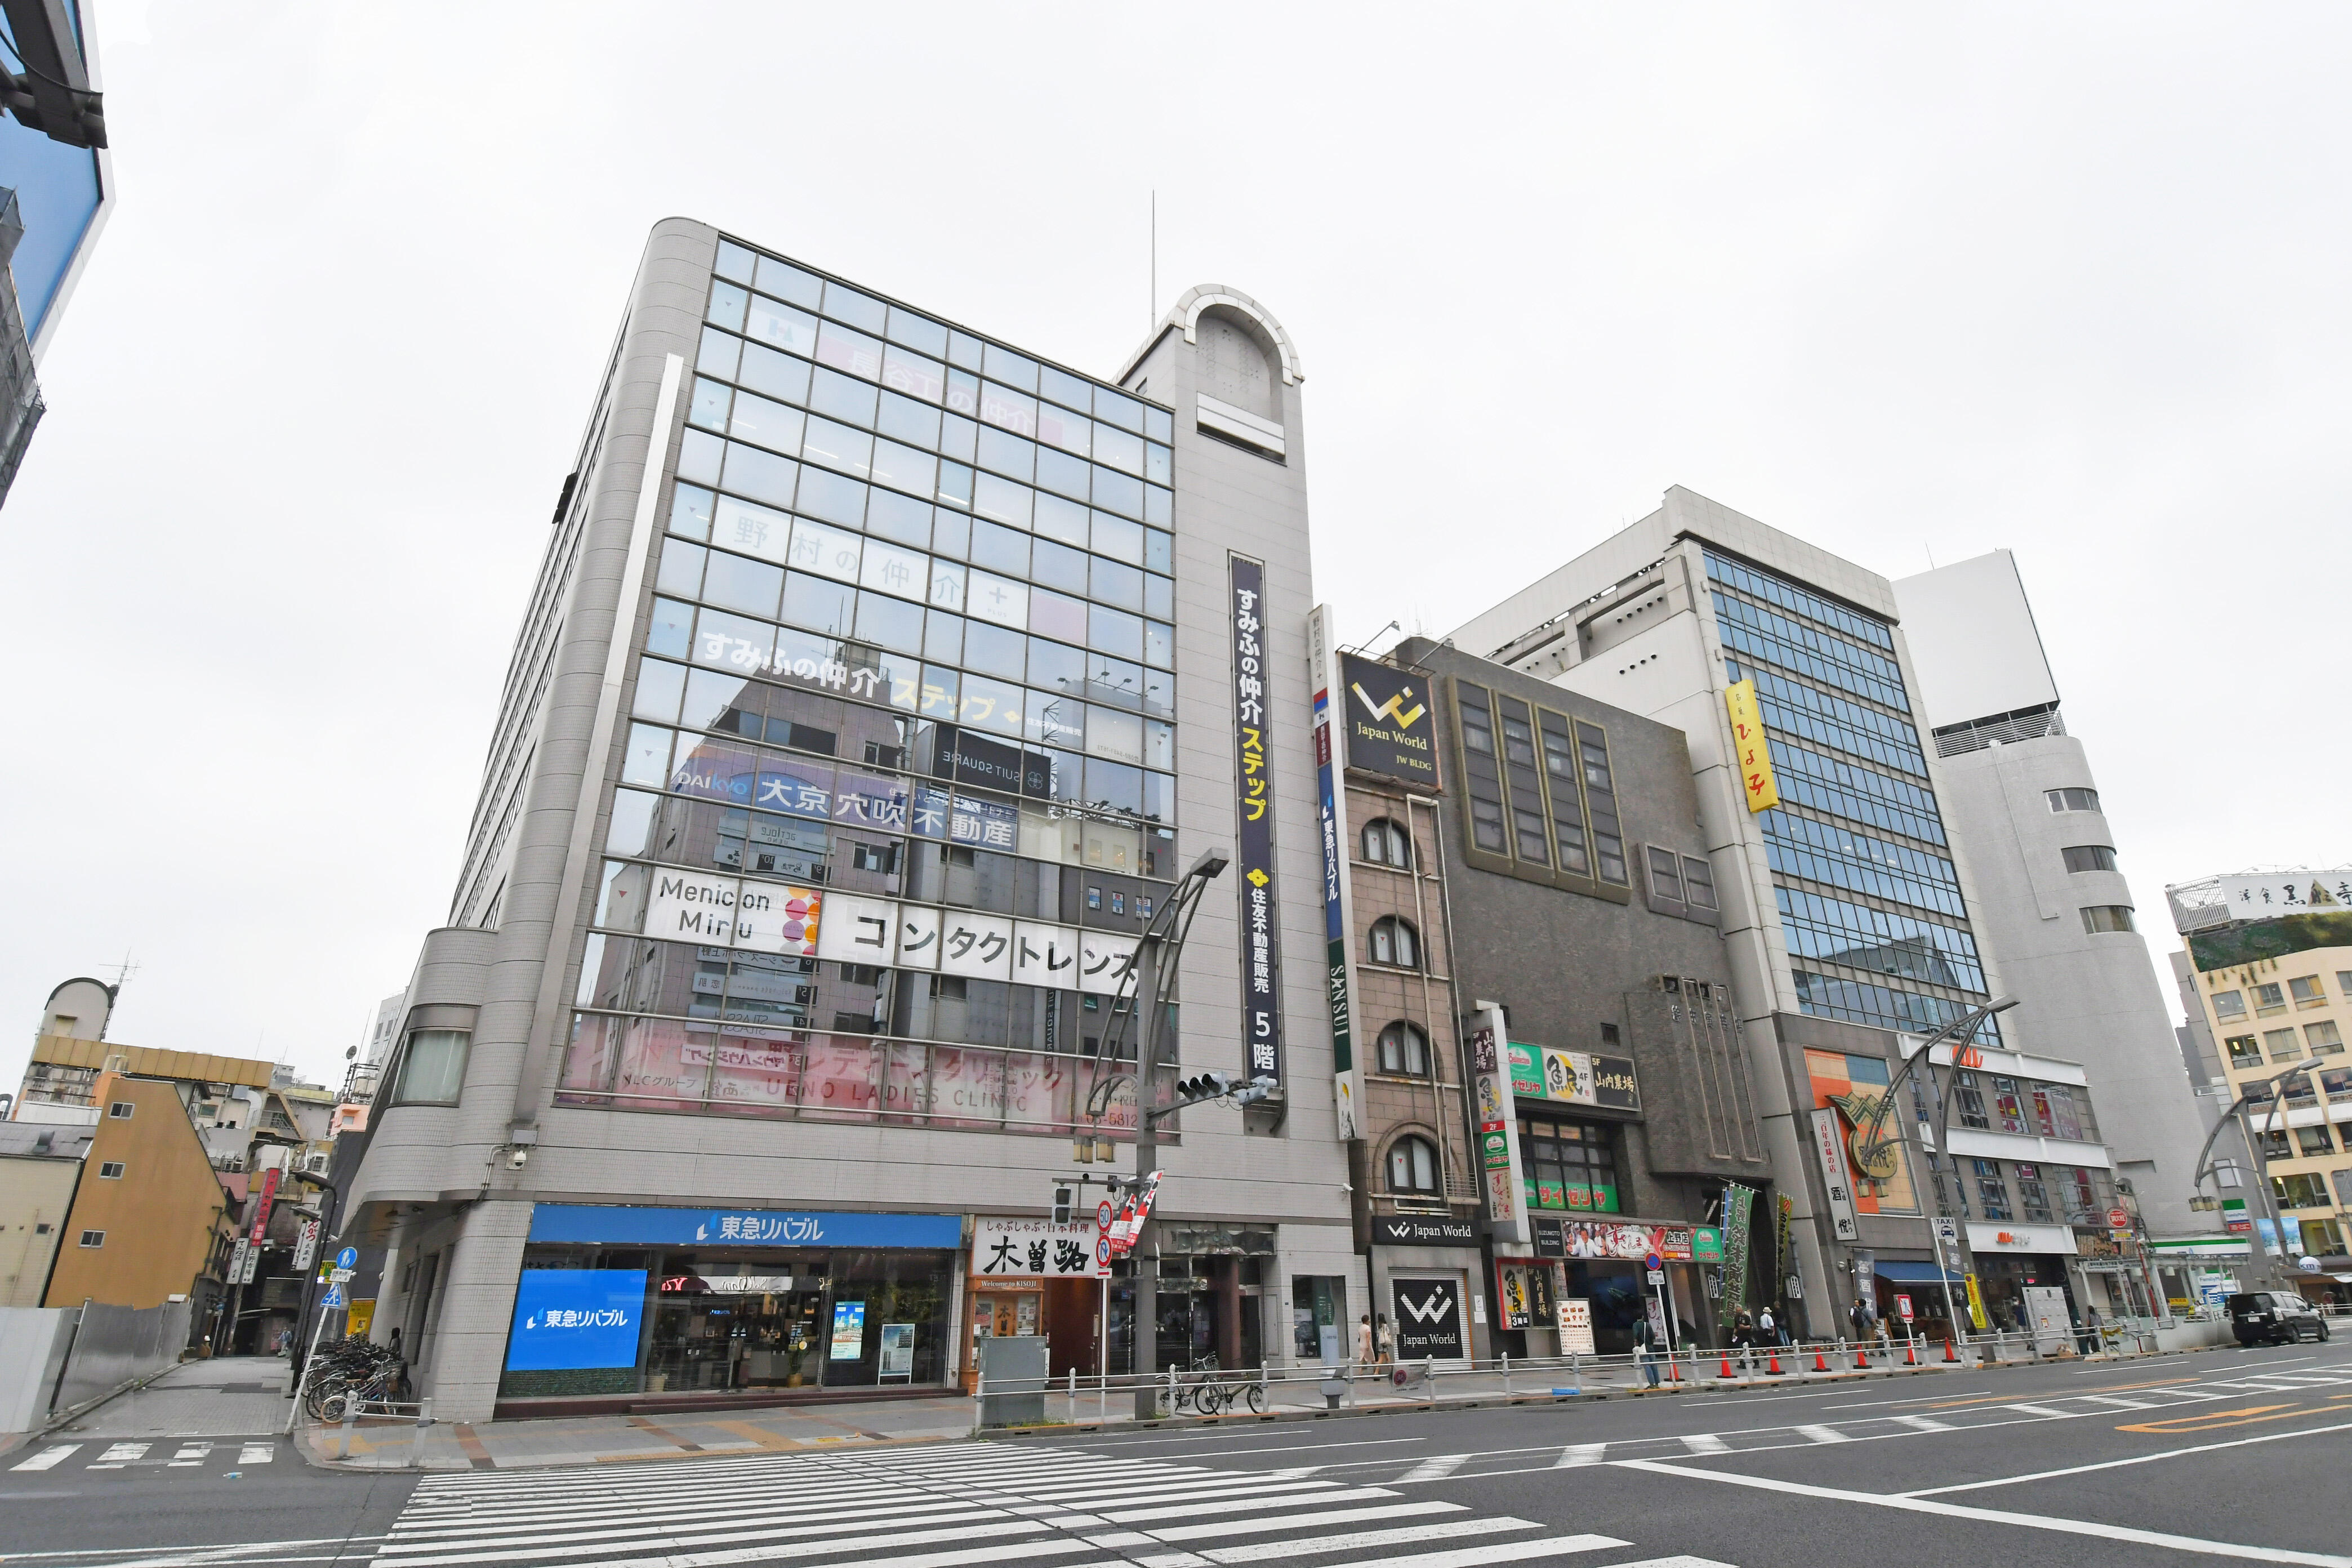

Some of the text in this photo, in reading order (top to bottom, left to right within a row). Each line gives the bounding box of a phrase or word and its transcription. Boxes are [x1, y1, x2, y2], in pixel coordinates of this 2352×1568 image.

[848, 350, 1034, 435] 長谷工の仲介
[733, 515, 961, 603] 野村の仲介
[702, 631, 996, 721] すみふの仲介 ステップ
[1237, 589, 1267, 821] すみふの仲介 ステップ
[1026, 717, 1082, 737] 住友不動産販売
[1357, 721, 1427, 750] Japan World
[1396, 755, 1432, 770] JW BLDG
[1736, 724, 1765, 796] ひよ子
[1324, 819, 1338, 901] 東急リバブル
[660, 876, 770, 912] Menicon
[679, 910, 752, 941] Miru
[854, 916, 1138, 982] コンタクトレンズ
[1251, 888, 1269, 993] 住友不動産販売
[1330, 965, 1348, 1037] SANSUI
[1952, 1045, 1983, 1068] au
[1511, 1079, 1542, 1094] イゼリヤ
[1579, 1072, 1588, 1081] 4F
[1596, 1071, 1634, 1093] 山内農場
[1539, 1186, 1606, 1206] サイゼリヤ
[719, 1215, 824, 1240] 東急リバブル
[987, 1220, 1090, 1235] しゃぶしゃぶ・日本料理
[1100, 1209, 1109, 1223] 50
[1414, 1224, 1472, 1239] Japan World
[1667, 1231, 1689, 1245] 上野店
[983, 1235, 1090, 1274] 木曽路
[545, 1308, 629, 1328] 東急リバブル
[1403, 1333, 1456, 1348] Japan World
